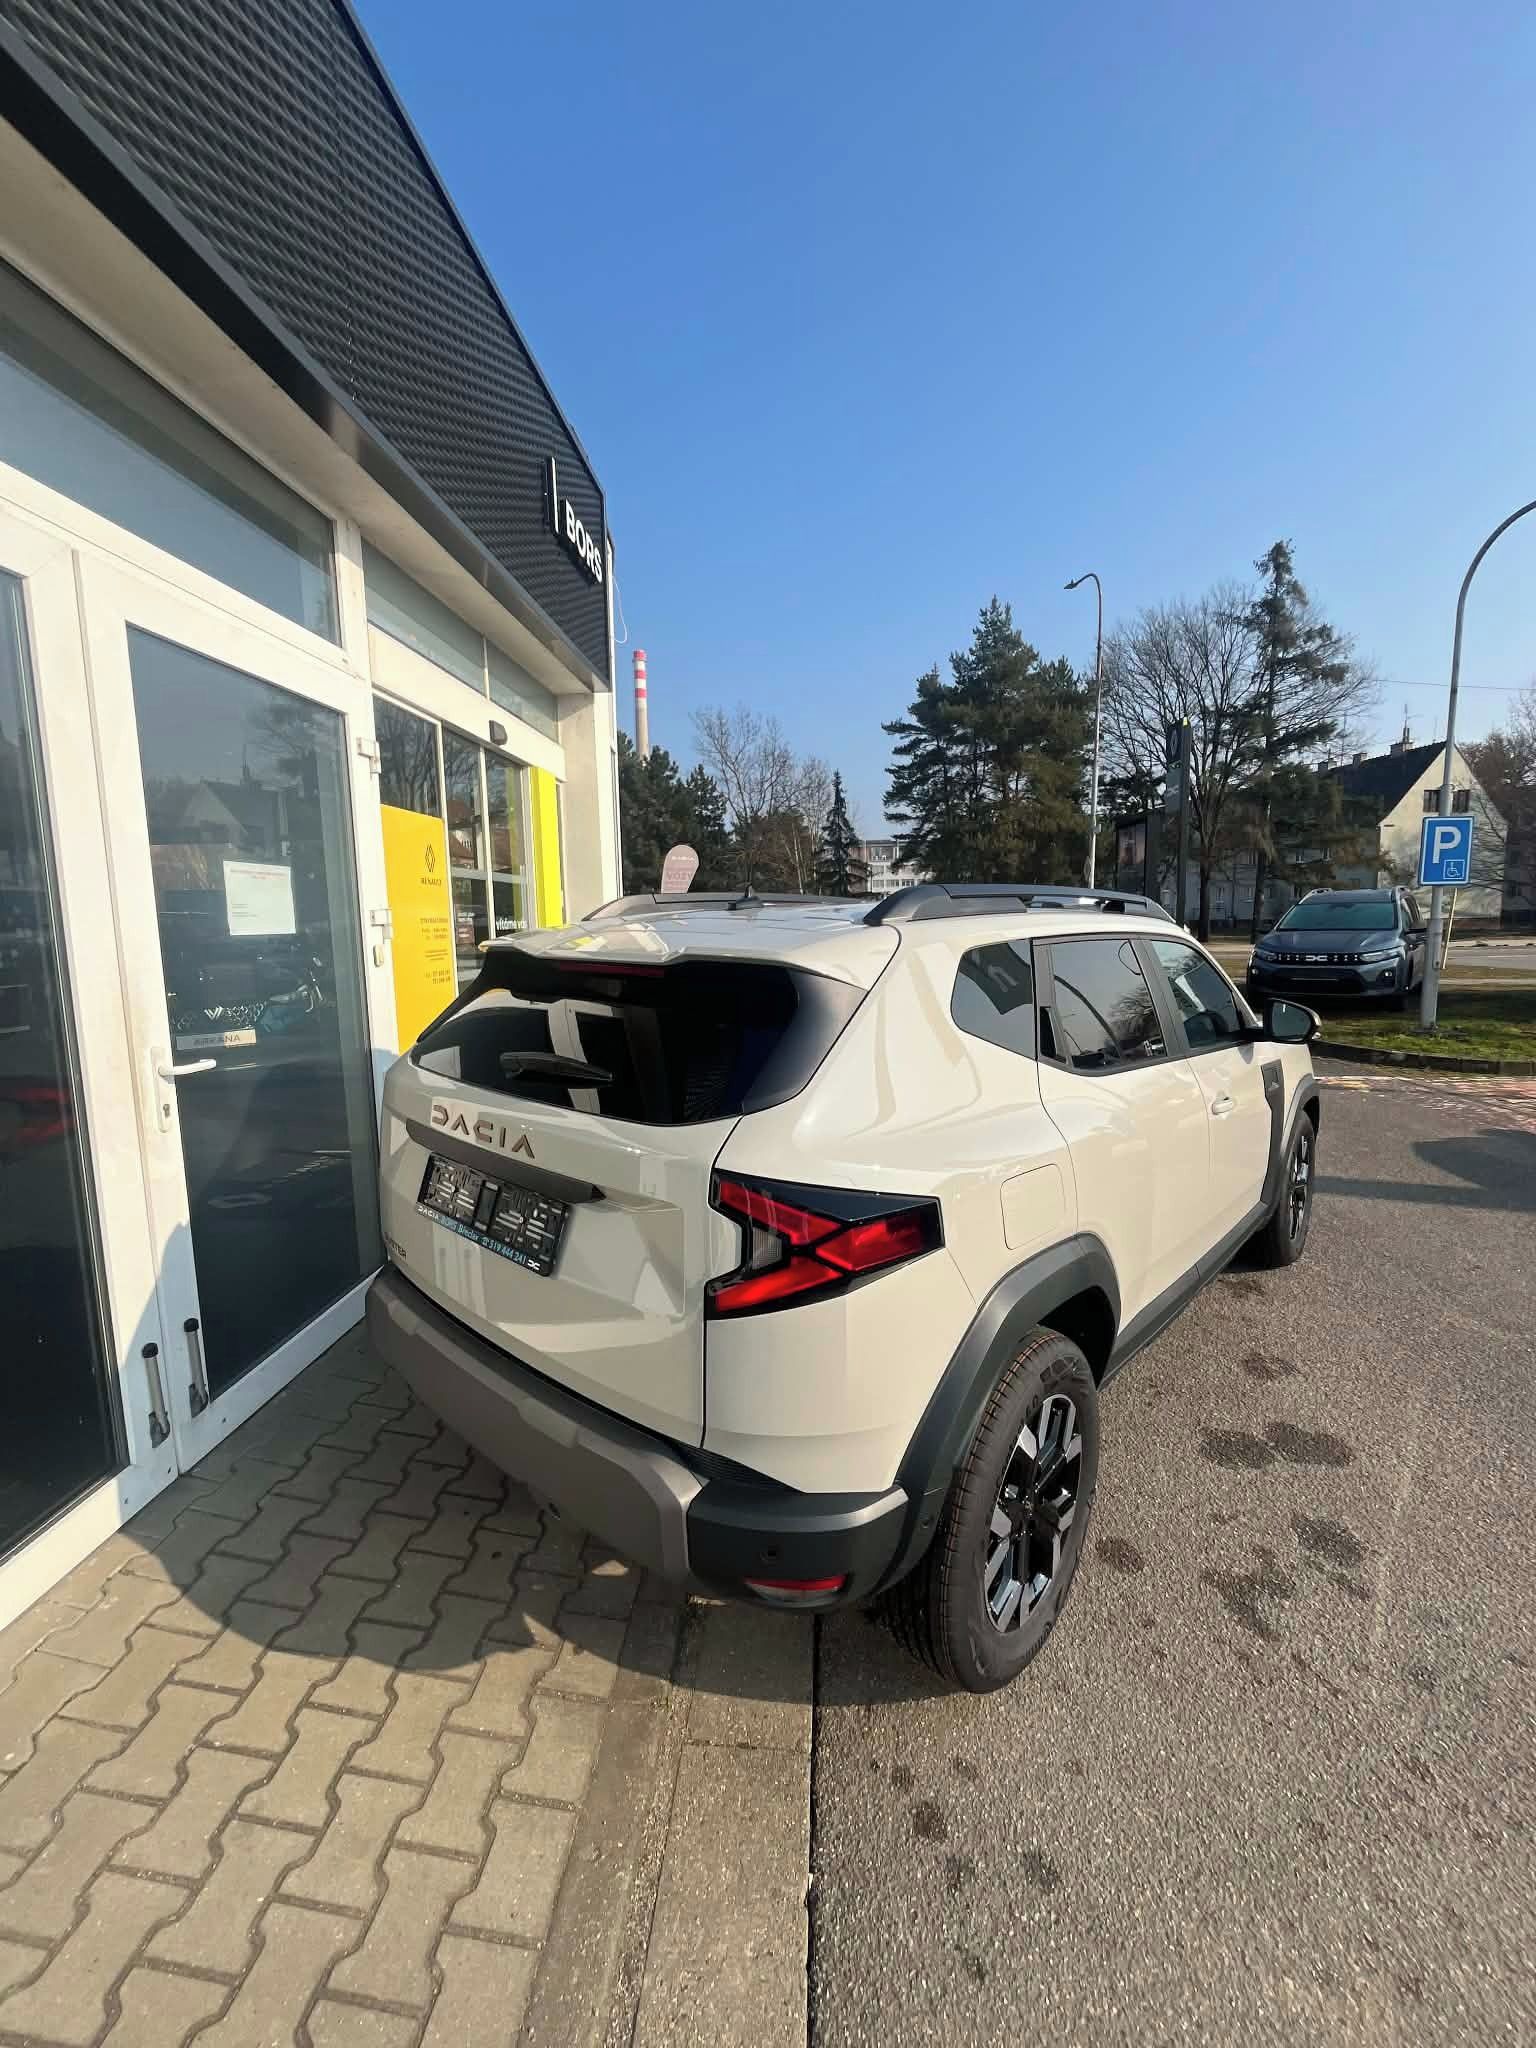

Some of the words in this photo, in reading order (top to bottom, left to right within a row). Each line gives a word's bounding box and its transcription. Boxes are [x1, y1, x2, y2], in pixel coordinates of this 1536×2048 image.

[565, 499, 603, 584] BORS
[1432, 826, 1461, 864] P
[431, 1104, 536, 1160] DACIA
[417, 1206, 439, 1220] DACIA
[514, 1252, 527, 1265] 241
